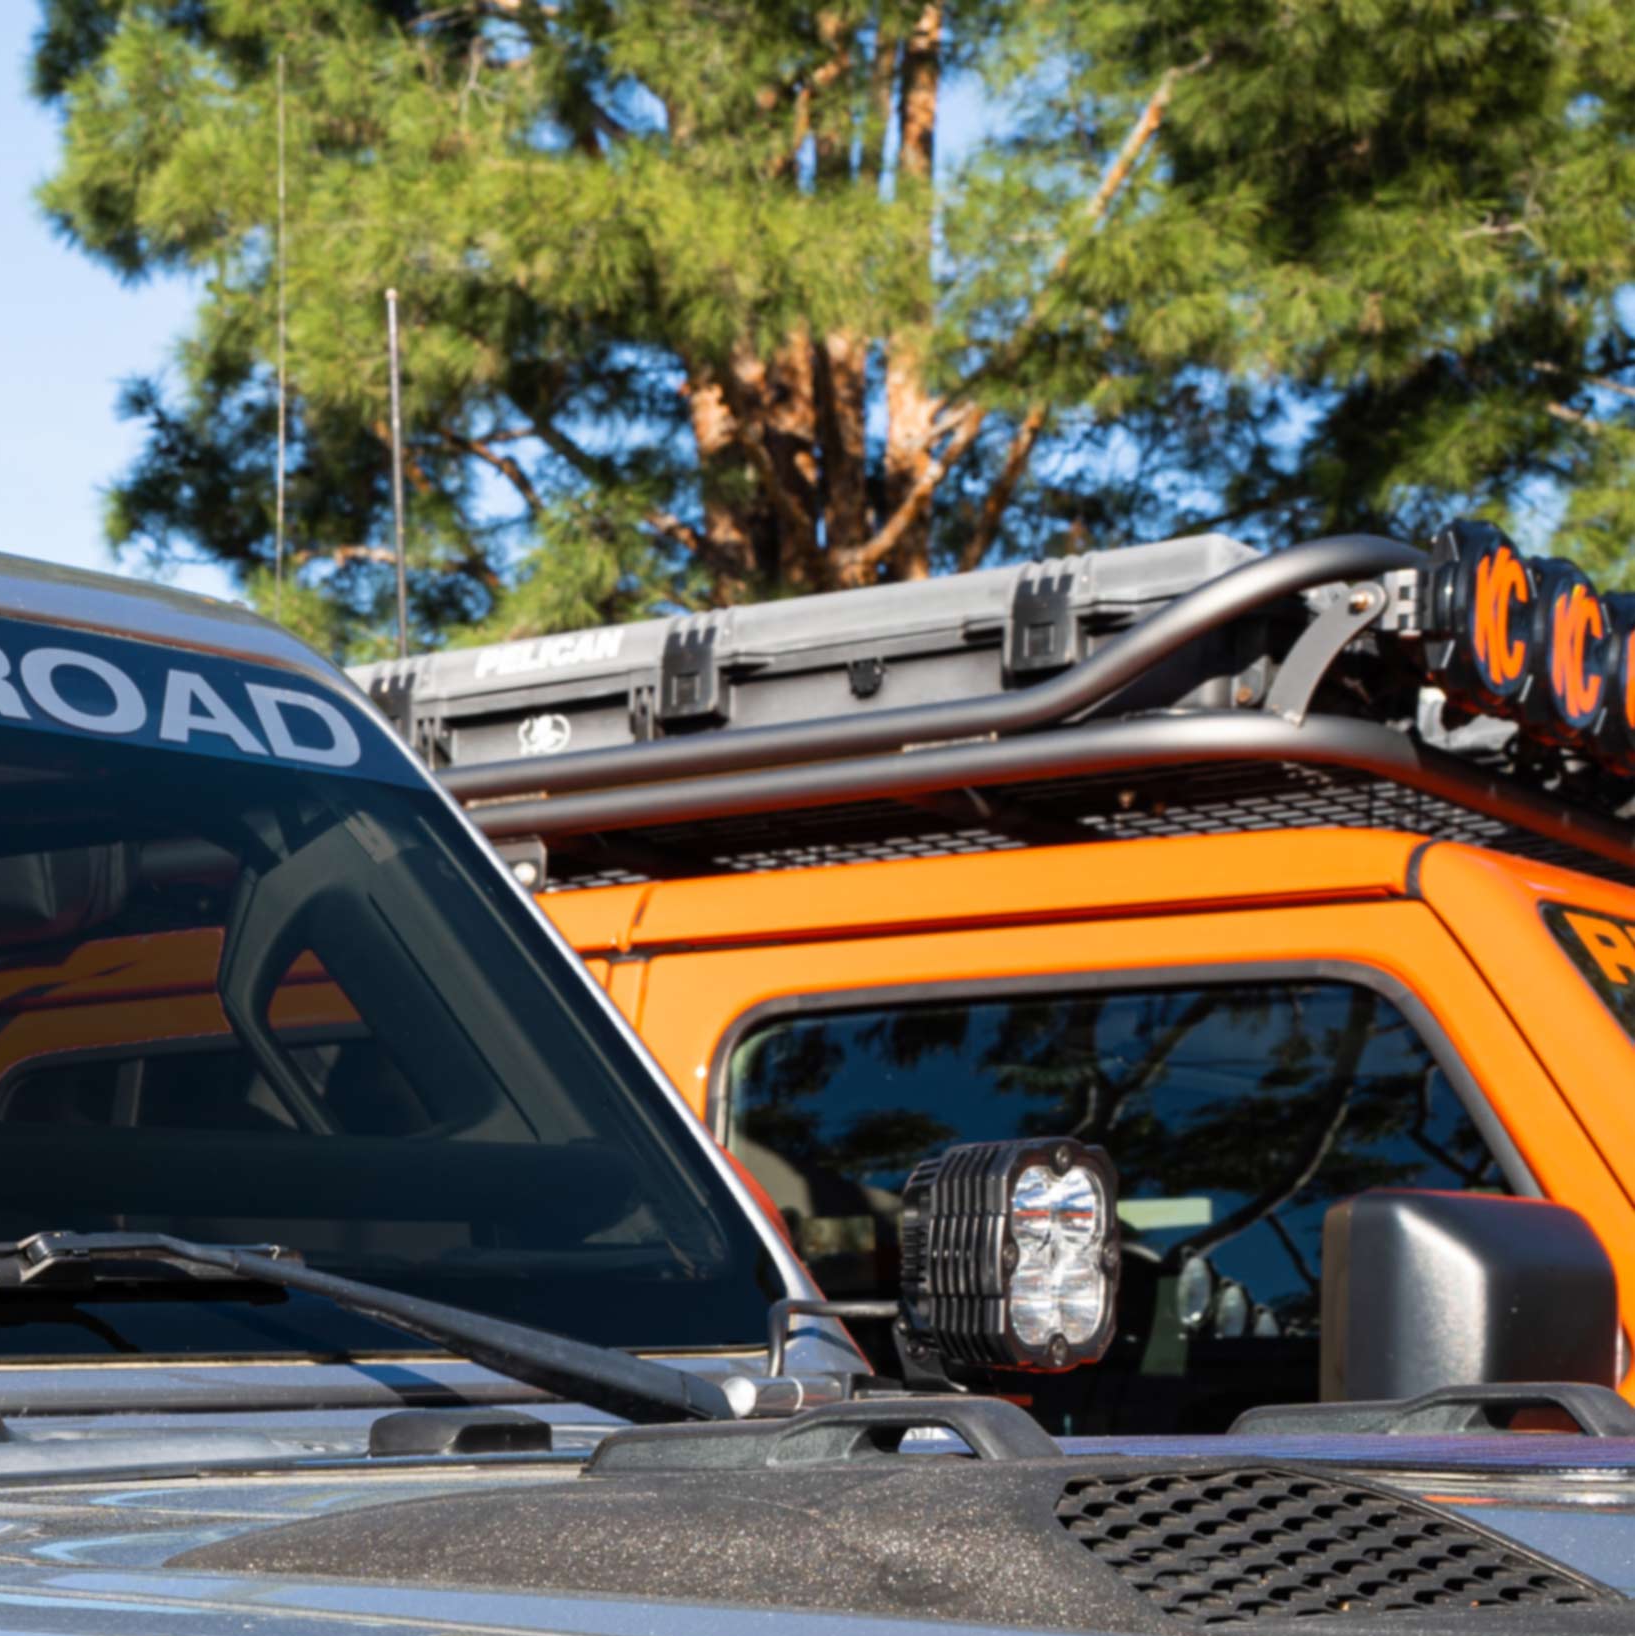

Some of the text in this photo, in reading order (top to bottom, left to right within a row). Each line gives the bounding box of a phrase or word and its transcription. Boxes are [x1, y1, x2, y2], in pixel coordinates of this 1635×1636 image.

[475, 628, 624, 679] PELICAN
[1474, 546, 1528, 685] KC
[1553, 584, 1603, 719] KC
